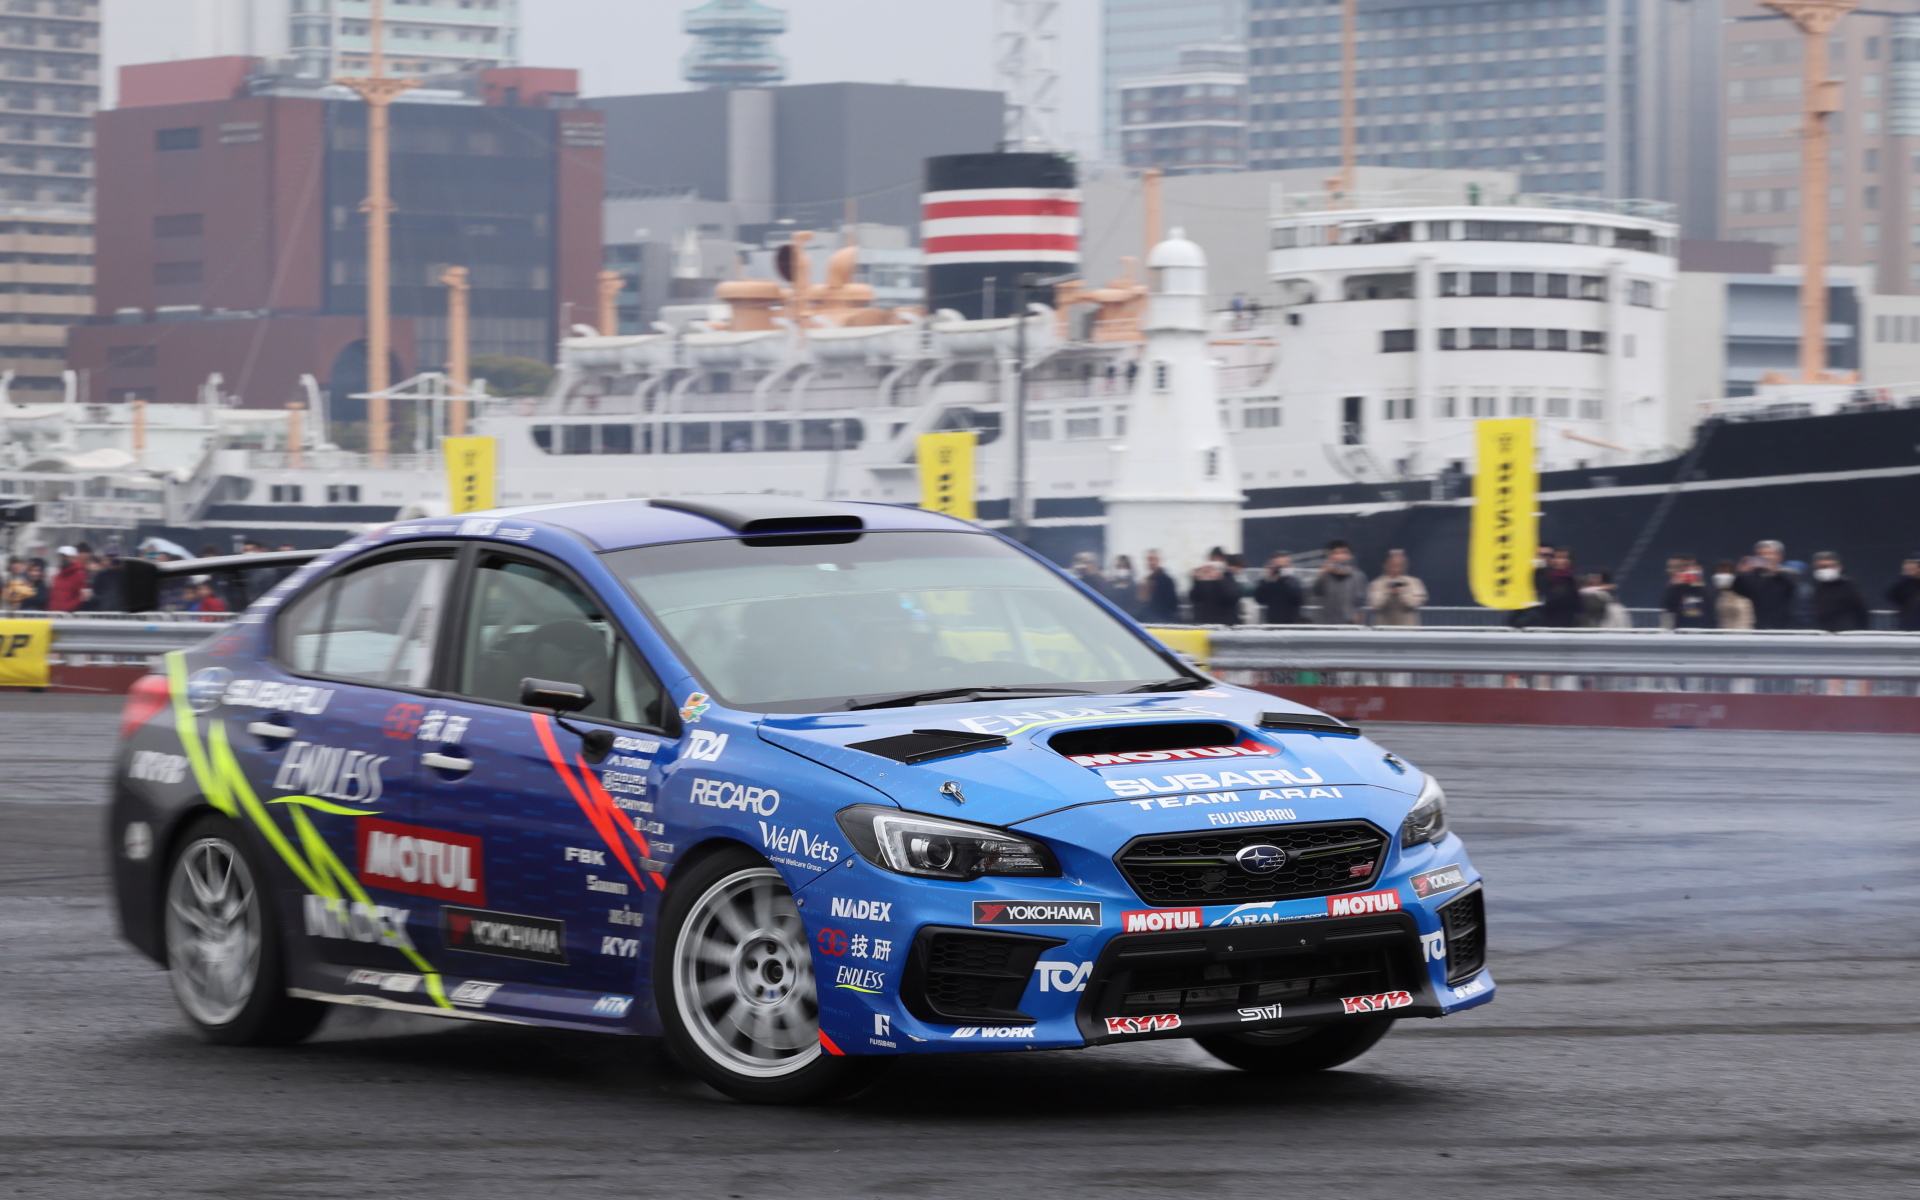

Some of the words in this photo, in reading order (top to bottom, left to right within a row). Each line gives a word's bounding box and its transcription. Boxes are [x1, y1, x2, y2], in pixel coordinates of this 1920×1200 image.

[1079, 745, 1267, 767] MOTUL
[1106, 767, 1323, 797] SUBARU
[690, 778, 780, 816] RECARO
[1130, 791, 1240, 810] TEAM
[1257, 787, 1343, 802] ARAI
[1207, 808, 1297, 827] FUJISUBARU
[758, 821, 839, 862] WellVets
[365, 831, 477, 892] MOTUL
[769, 855, 786, 865] Animal
[785, 857, 806, 869] Wellcare
[807, 862, 822, 872] Group
[831, 897, 892, 922] NADEX
[1006, 905, 1094, 921] YOKOHAMA
[1332, 892, 1398, 917] MOTUL
[1127, 911, 1200, 932] MOTUL
[1228, 913, 1279, 927] ARAI
[1279, 911, 1329, 922] motorsport
[836, 965, 885, 989] ENDLESS
[1340, 990, 1414, 1014] KYB
[981, 1027, 1036, 1038] WORK
[1104, 1013, 1182, 1034] KYB
